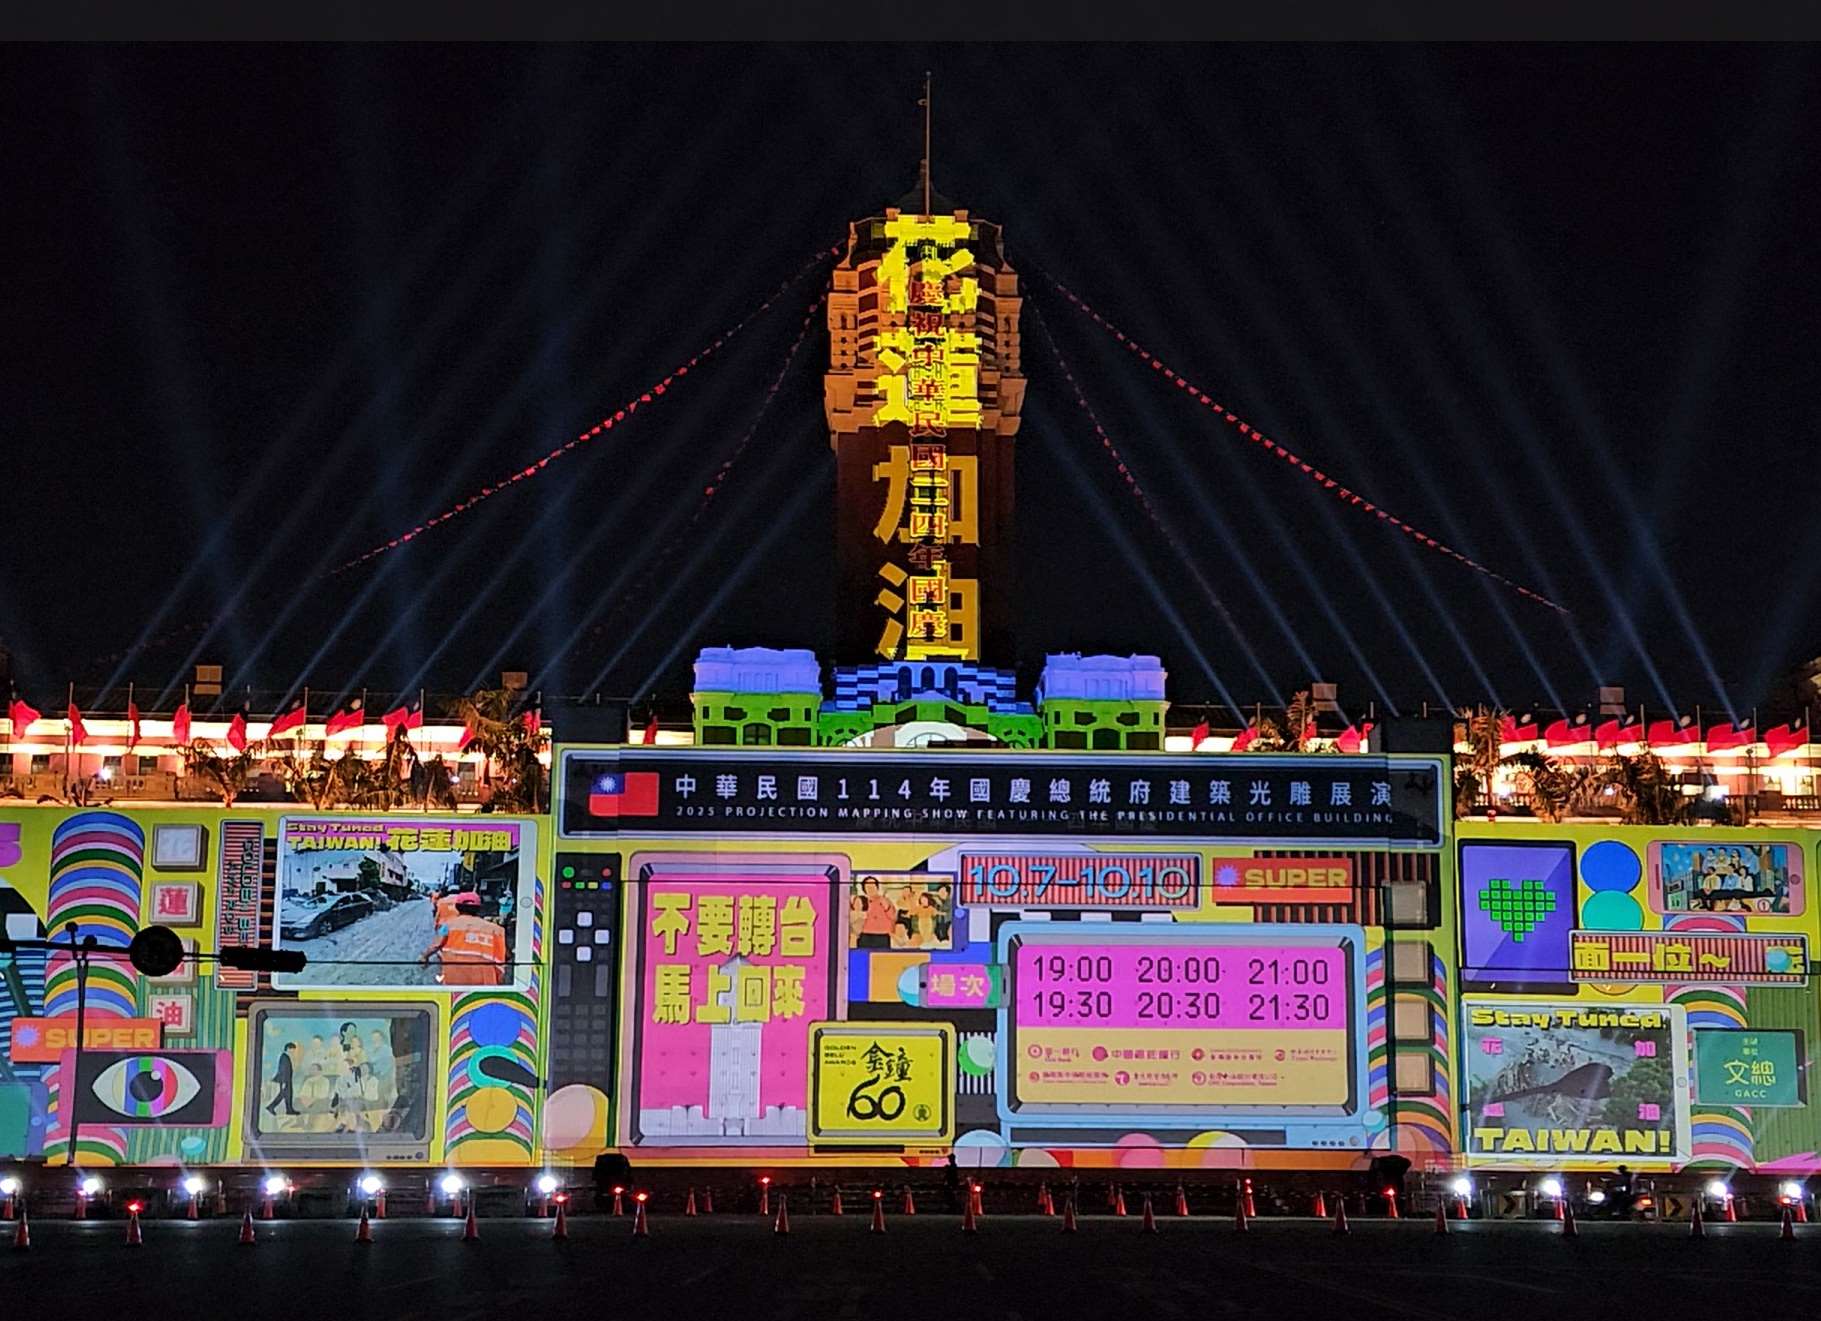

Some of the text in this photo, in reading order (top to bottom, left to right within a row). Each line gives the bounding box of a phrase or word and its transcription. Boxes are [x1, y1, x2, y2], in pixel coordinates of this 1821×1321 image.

[676, 806, 1393, 824] 2025 PROJECTION MAPPING SHOW FEATURING THE PRESIDENTIAL OFFICE BUILDING
[287, 835, 382, 850] TAIWAN!
[1244, 867, 1348, 889] SUPER
[1033, 955, 1329, 986] 19:00 20:00 21:00
[652, 963, 806, 1026] 馬上回來
[1033, 991, 1330, 1021] 19:30 20:30 21:30
[1471, 1008, 1664, 1029] Stay Tuned
[45, 1027, 156, 1048] SUPER
[846, 1074, 907, 1121] 60
[1474, 1128, 1672, 1153] TAIWAN!
